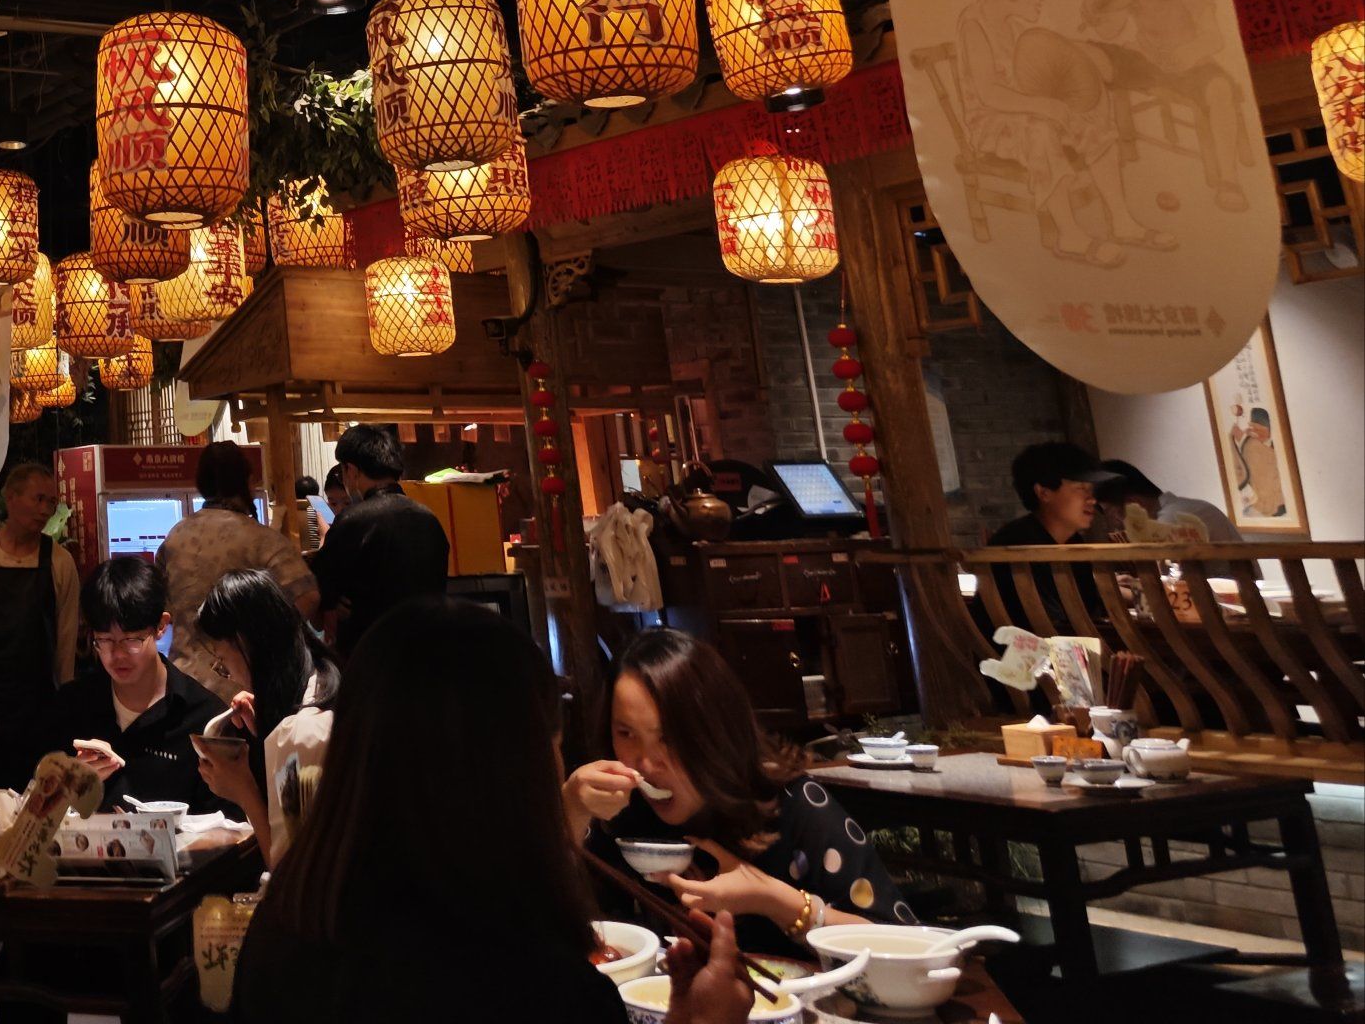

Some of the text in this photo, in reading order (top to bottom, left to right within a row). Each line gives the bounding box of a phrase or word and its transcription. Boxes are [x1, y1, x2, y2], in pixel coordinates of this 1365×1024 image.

[105, 29, 175, 172] 一帆风顺
[1168, 591, 1192, 611] 23
